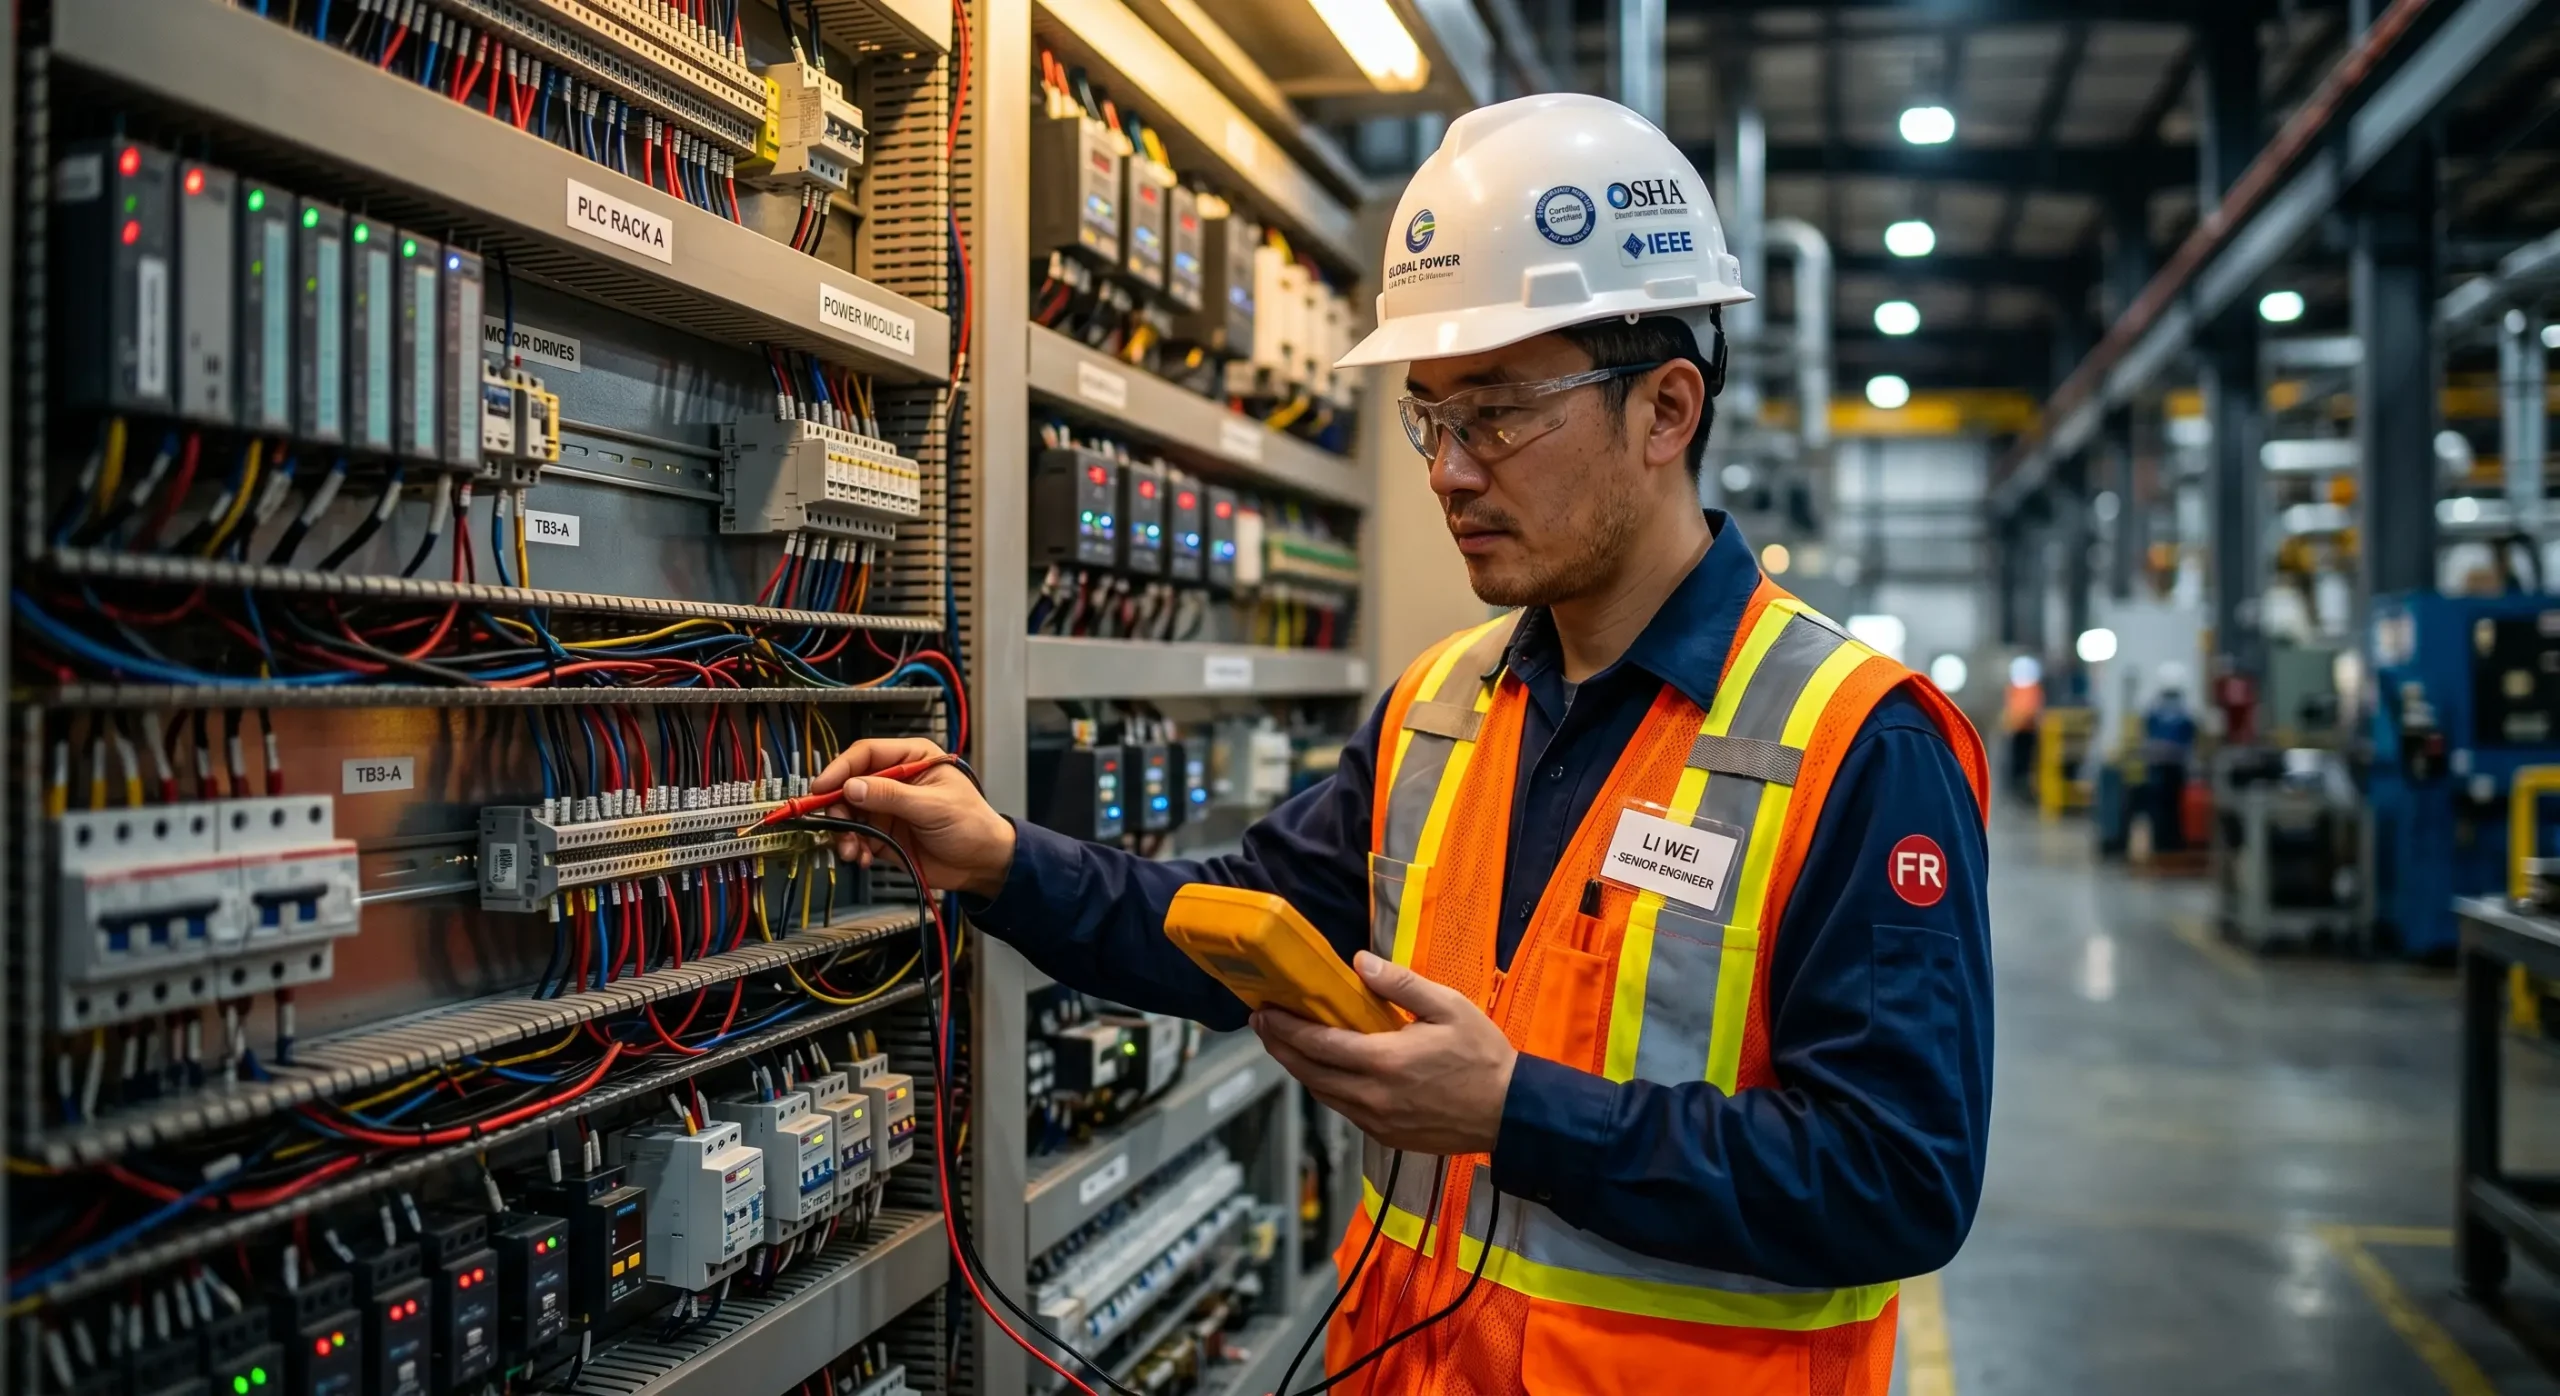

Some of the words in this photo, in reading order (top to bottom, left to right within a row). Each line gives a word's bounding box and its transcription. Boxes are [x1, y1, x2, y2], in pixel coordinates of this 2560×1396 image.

[1607, 179, 1687, 210] OSHA
[578, 196, 606, 225] PLC
[611, 210, 651, 244] RACK
[654, 228, 664, 248] A
[1647, 231, 1693, 255] IEEE
[1388, 260, 1418, 279] GLOBAL
[1419, 254, 1461, 270] POWER
[824, 296, 862, 326] POWER
[863, 311, 902, 341] MODULE
[904, 328, 910, 343] 4
[485, 324, 530, 350] MOOR
[533, 336, 575, 362] DRIVES
[535, 519, 570, 537] TB3-A
[355, 765, 402, 783] TB3-A
[1642, 833, 1661, 852] LI
[1664, 838, 1700, 864] WEI
[1618, 851, 1658, 872] SENIOR
[1658, 864, 1714, 890] ENGINEER
[1897, 851, 1942, 888] FR
